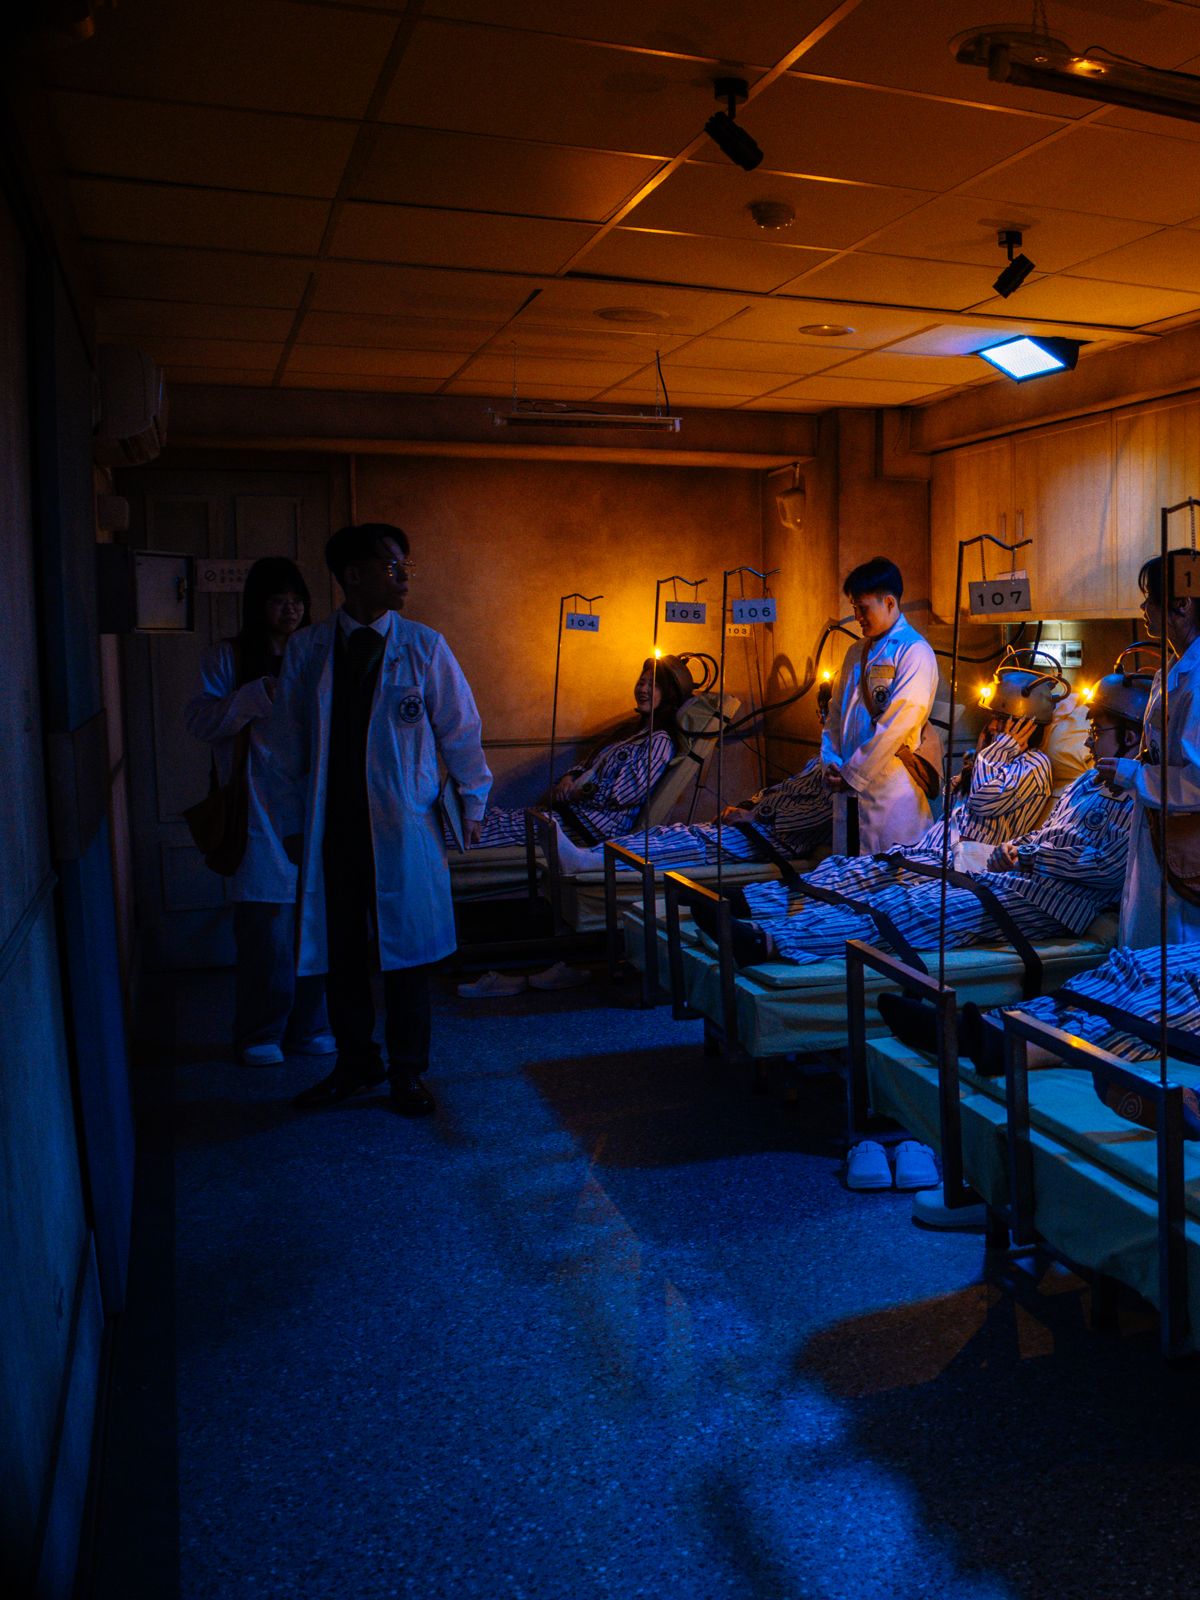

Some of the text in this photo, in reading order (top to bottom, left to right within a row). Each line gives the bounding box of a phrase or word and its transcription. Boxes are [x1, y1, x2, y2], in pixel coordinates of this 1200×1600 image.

[977, 590, 1022, 606] 107
[671, 609, 701, 619] 105
[737, 606, 771, 619] 106
[570, 619, 595, 628] 104
[728, 627, 747, 635] 103
